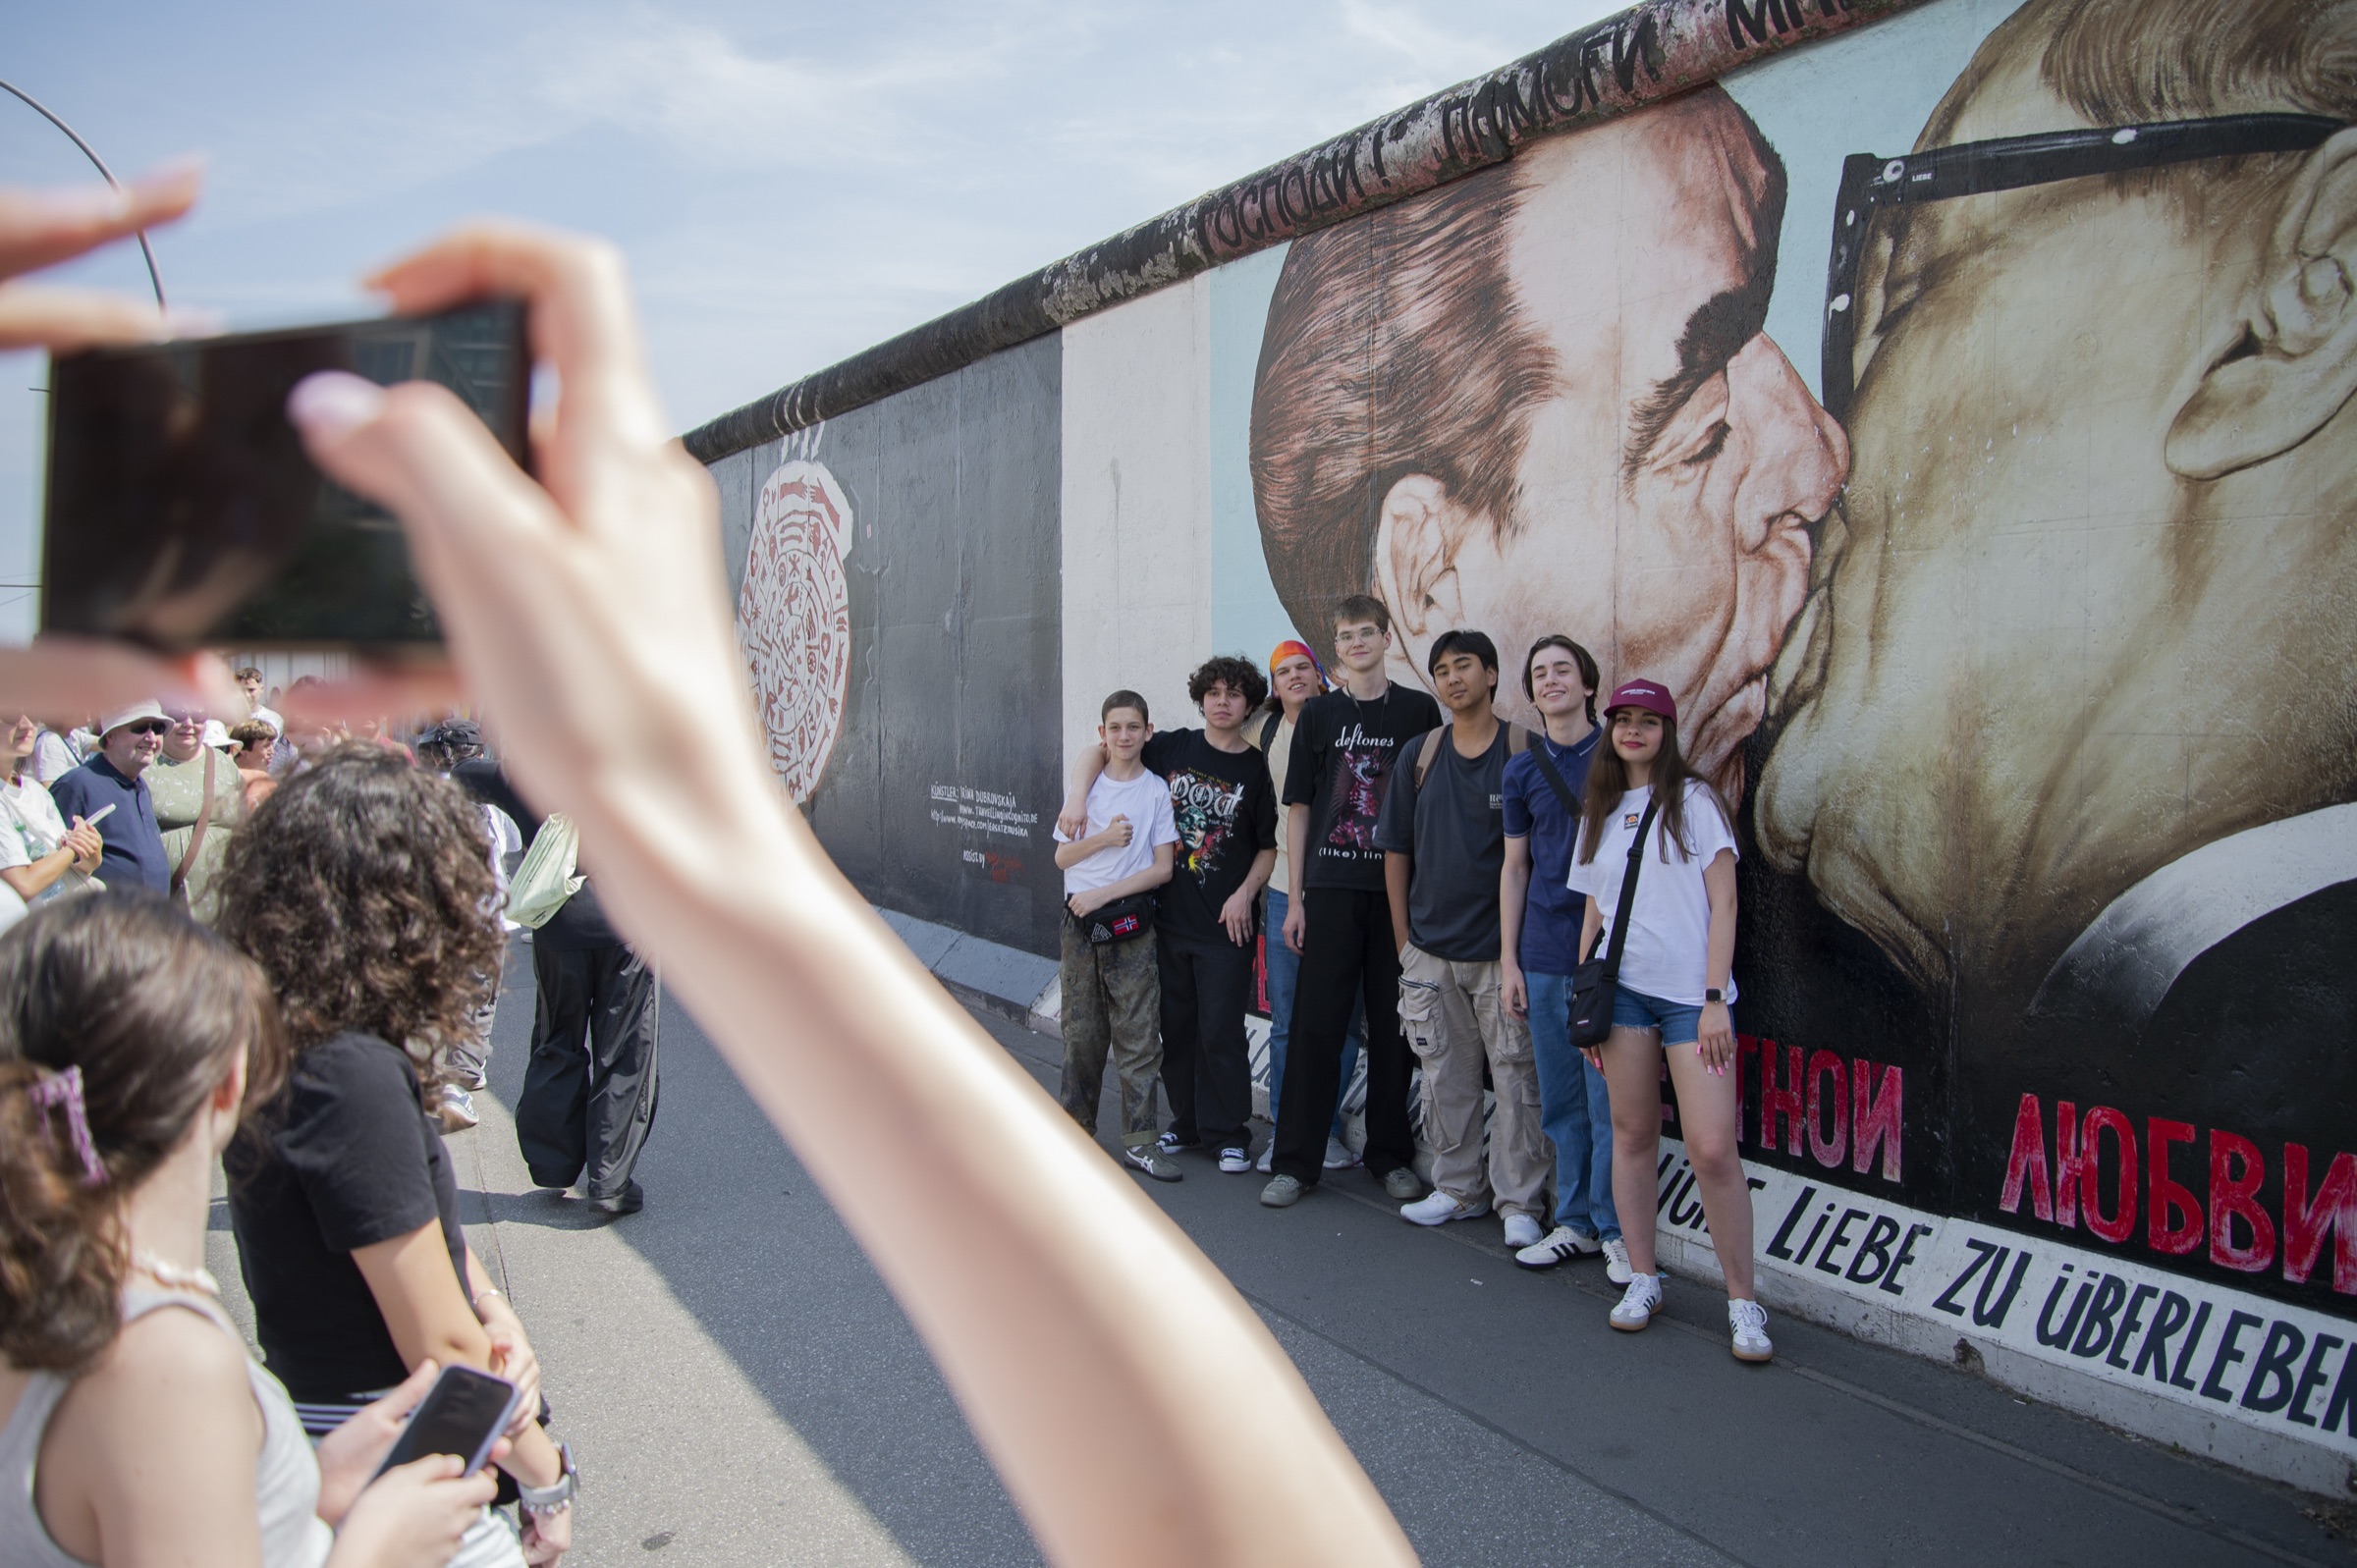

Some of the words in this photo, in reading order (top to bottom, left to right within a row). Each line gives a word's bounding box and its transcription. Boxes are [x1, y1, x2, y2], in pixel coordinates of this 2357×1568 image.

[1911, 172, 1933, 183] LIEBE
[1335, 723, 1394, 751] deftones
[1318, 847, 1357, 860] (like)
[1363, 850, 1386, 860] lin
[1999, 1092, 2357, 1296] ЛЮБВИ
[1931, 1237, 2033, 1329] ZU
